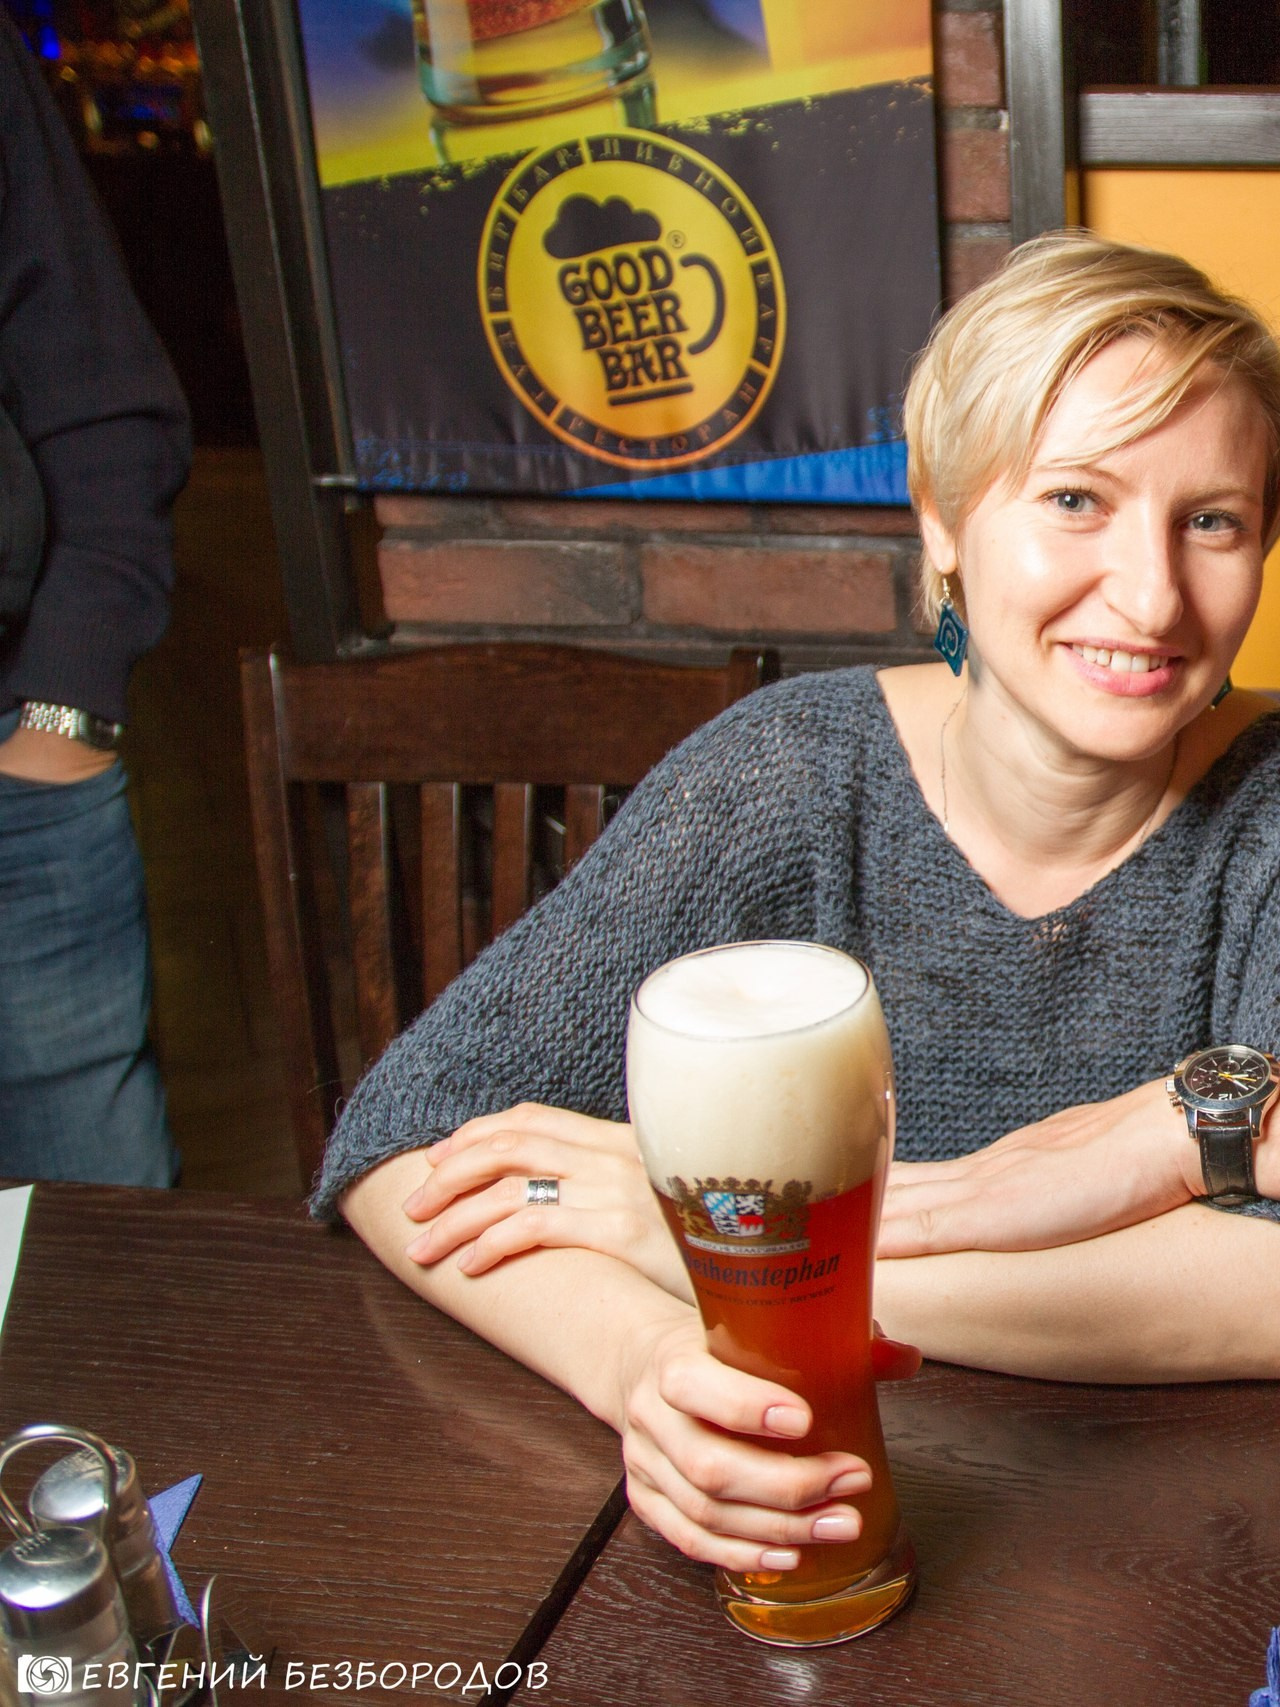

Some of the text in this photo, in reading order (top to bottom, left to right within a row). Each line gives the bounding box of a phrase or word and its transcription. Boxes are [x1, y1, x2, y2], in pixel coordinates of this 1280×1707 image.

[601, 137, 762, 254] ПИВНОЙ
[557, 246, 675, 306] GOOD
[573, 291, 690, 351] BEER
[600, 336, 690, 392] BAR
[567, 381, 758, 454] РЕСТОРАН
